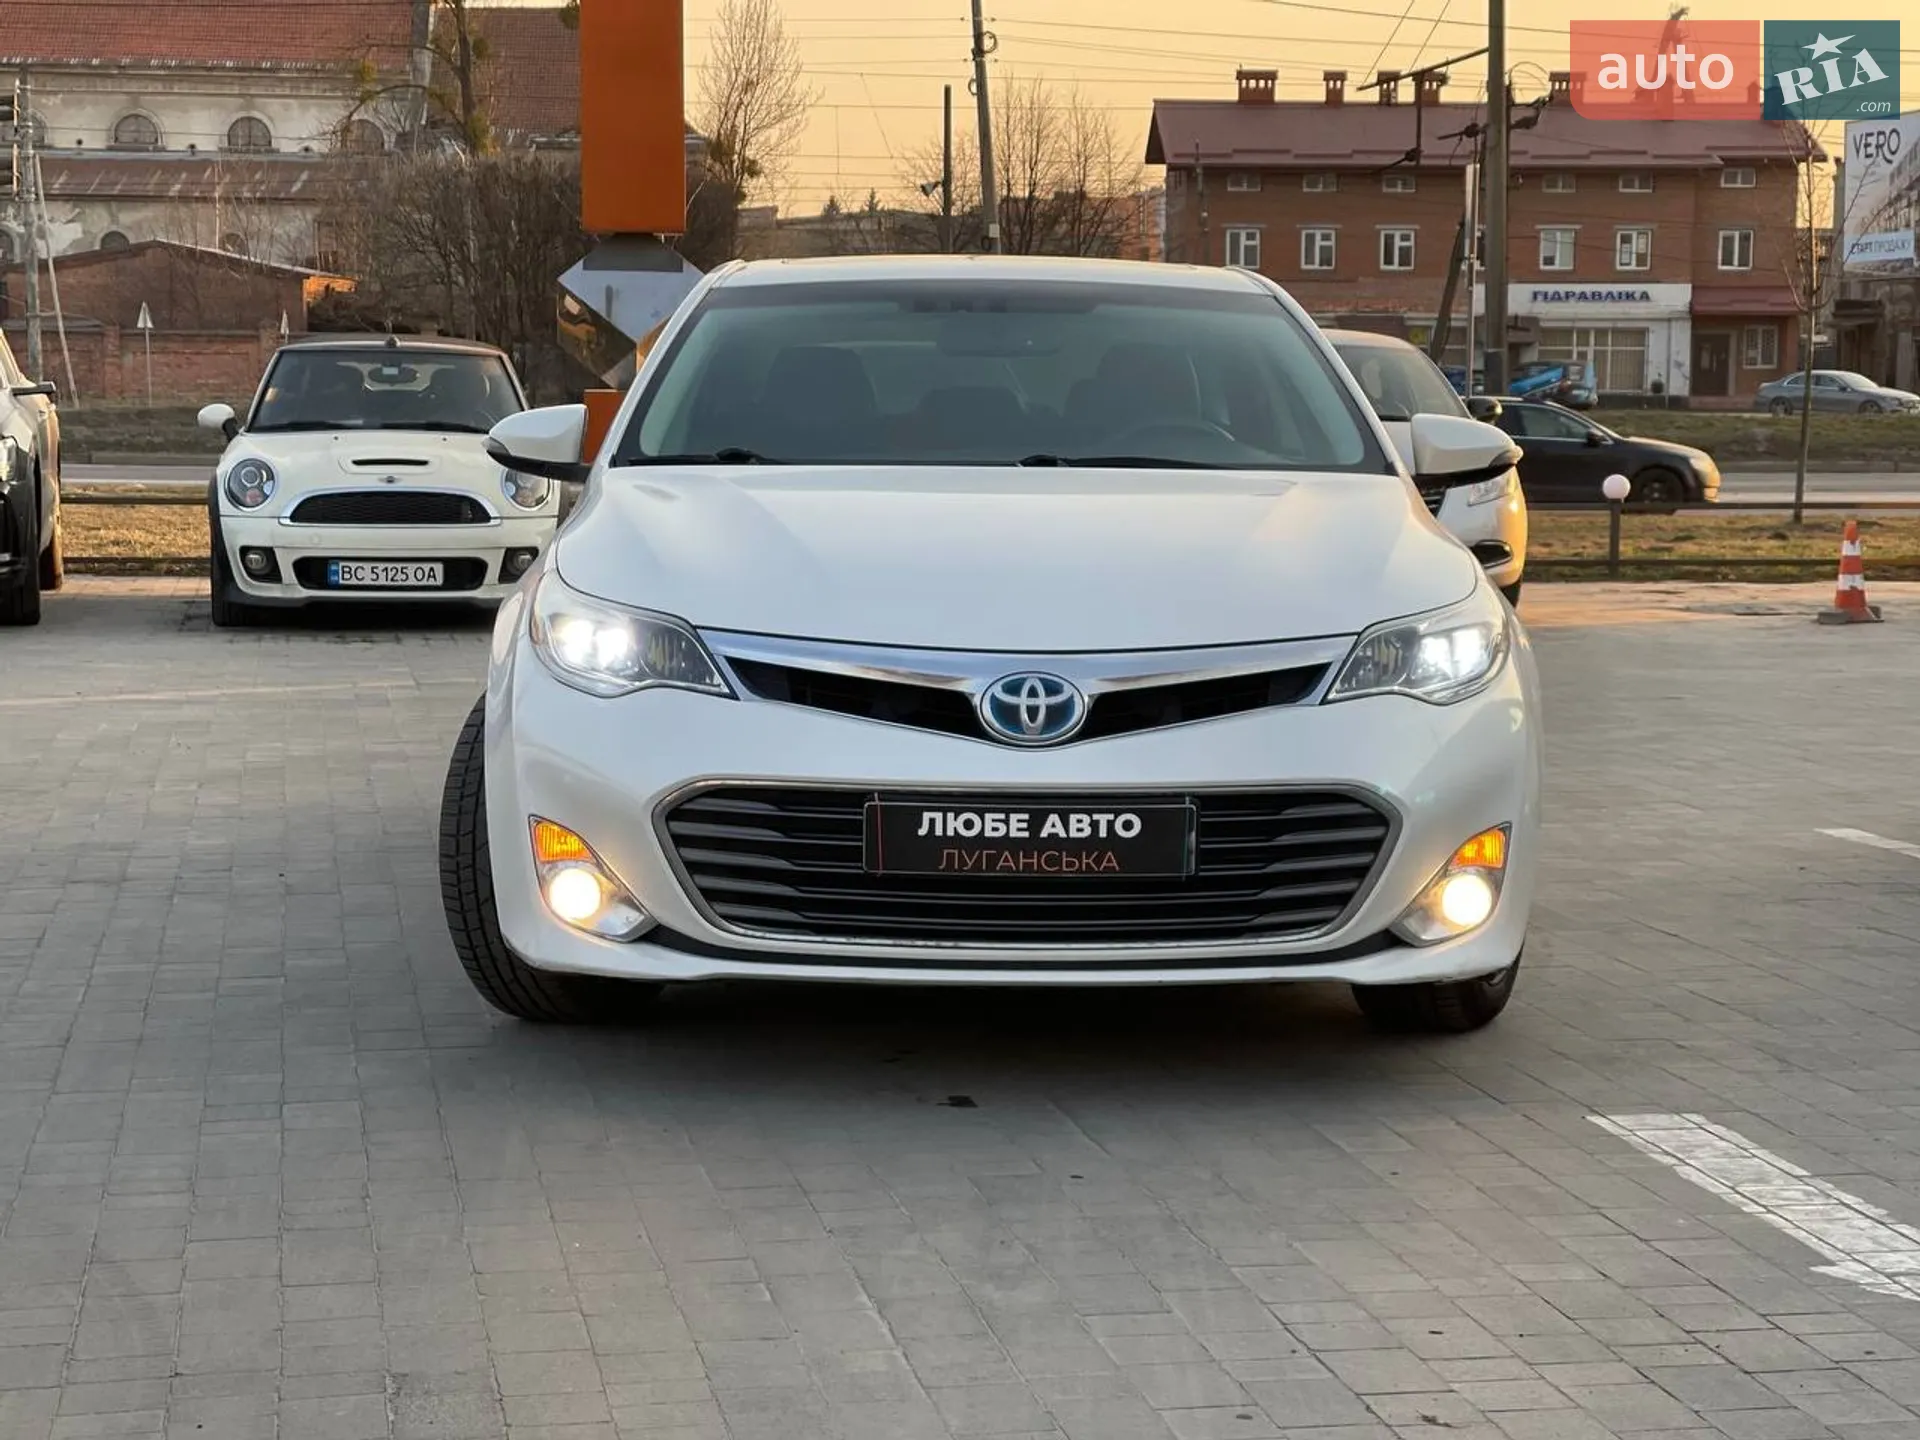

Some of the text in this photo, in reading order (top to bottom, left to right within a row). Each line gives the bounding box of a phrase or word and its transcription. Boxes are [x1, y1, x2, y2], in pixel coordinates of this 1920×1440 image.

[1853, 128, 1901, 164] VERO
[1532, 290, 1652, 302] ГІДРАВЛІКА
[340, 565, 366, 581] BC
[370, 566, 409, 582] 5125
[413, 566, 437, 582] OA
[917, 811, 1142, 839] ЛЮБЕ АВТО
[938, 849, 1120, 873] ЛУГАНСЬКА
